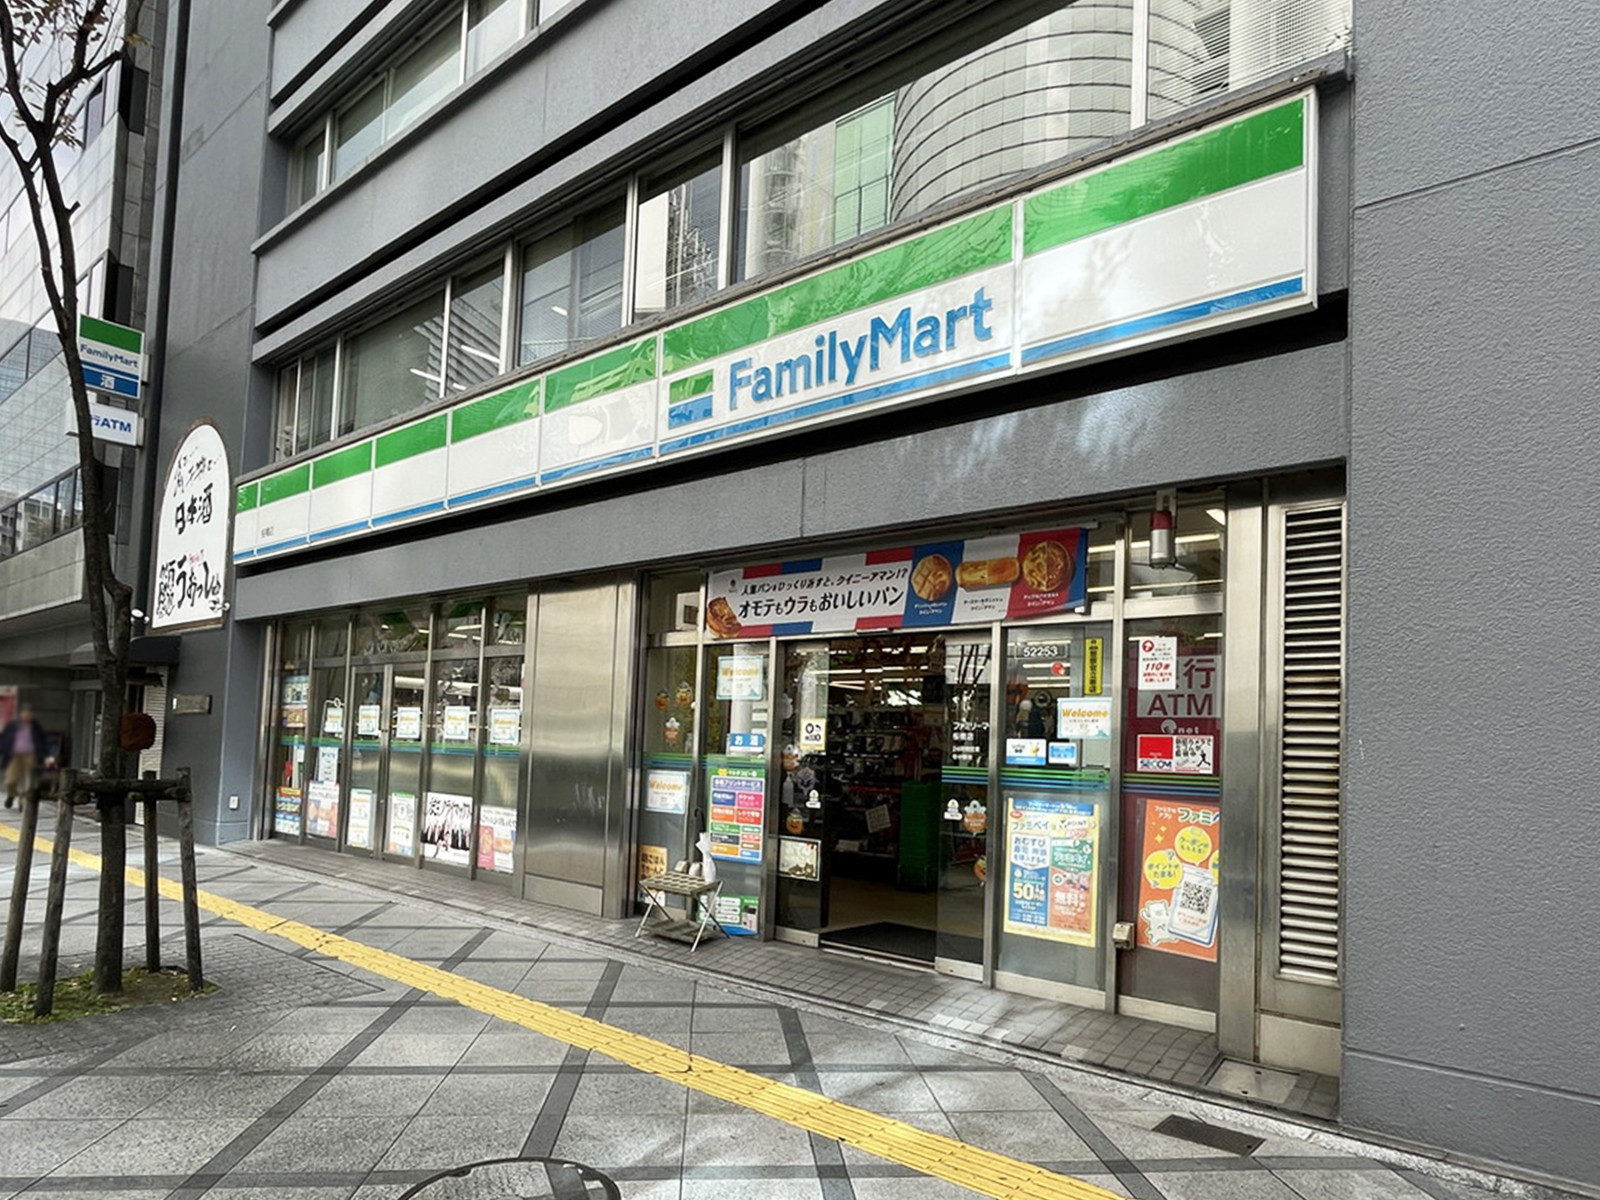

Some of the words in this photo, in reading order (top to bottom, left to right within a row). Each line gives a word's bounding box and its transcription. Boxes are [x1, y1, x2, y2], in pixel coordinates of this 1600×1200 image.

[80, 343, 139, 369] FamilyMart
[728, 286, 995, 412] FamilyMart
[175, 482, 213, 535] 日本酒
[738, 586, 905, 618] オモテもウラもおいしいパン
[1023, 645, 1058, 658] 52253
[1061, 708, 1109, 718] Welcome
[1147, 693, 1213, 717] ATM
[648, 780, 684, 791] Welcome
[1013, 882, 1035, 901] 50
